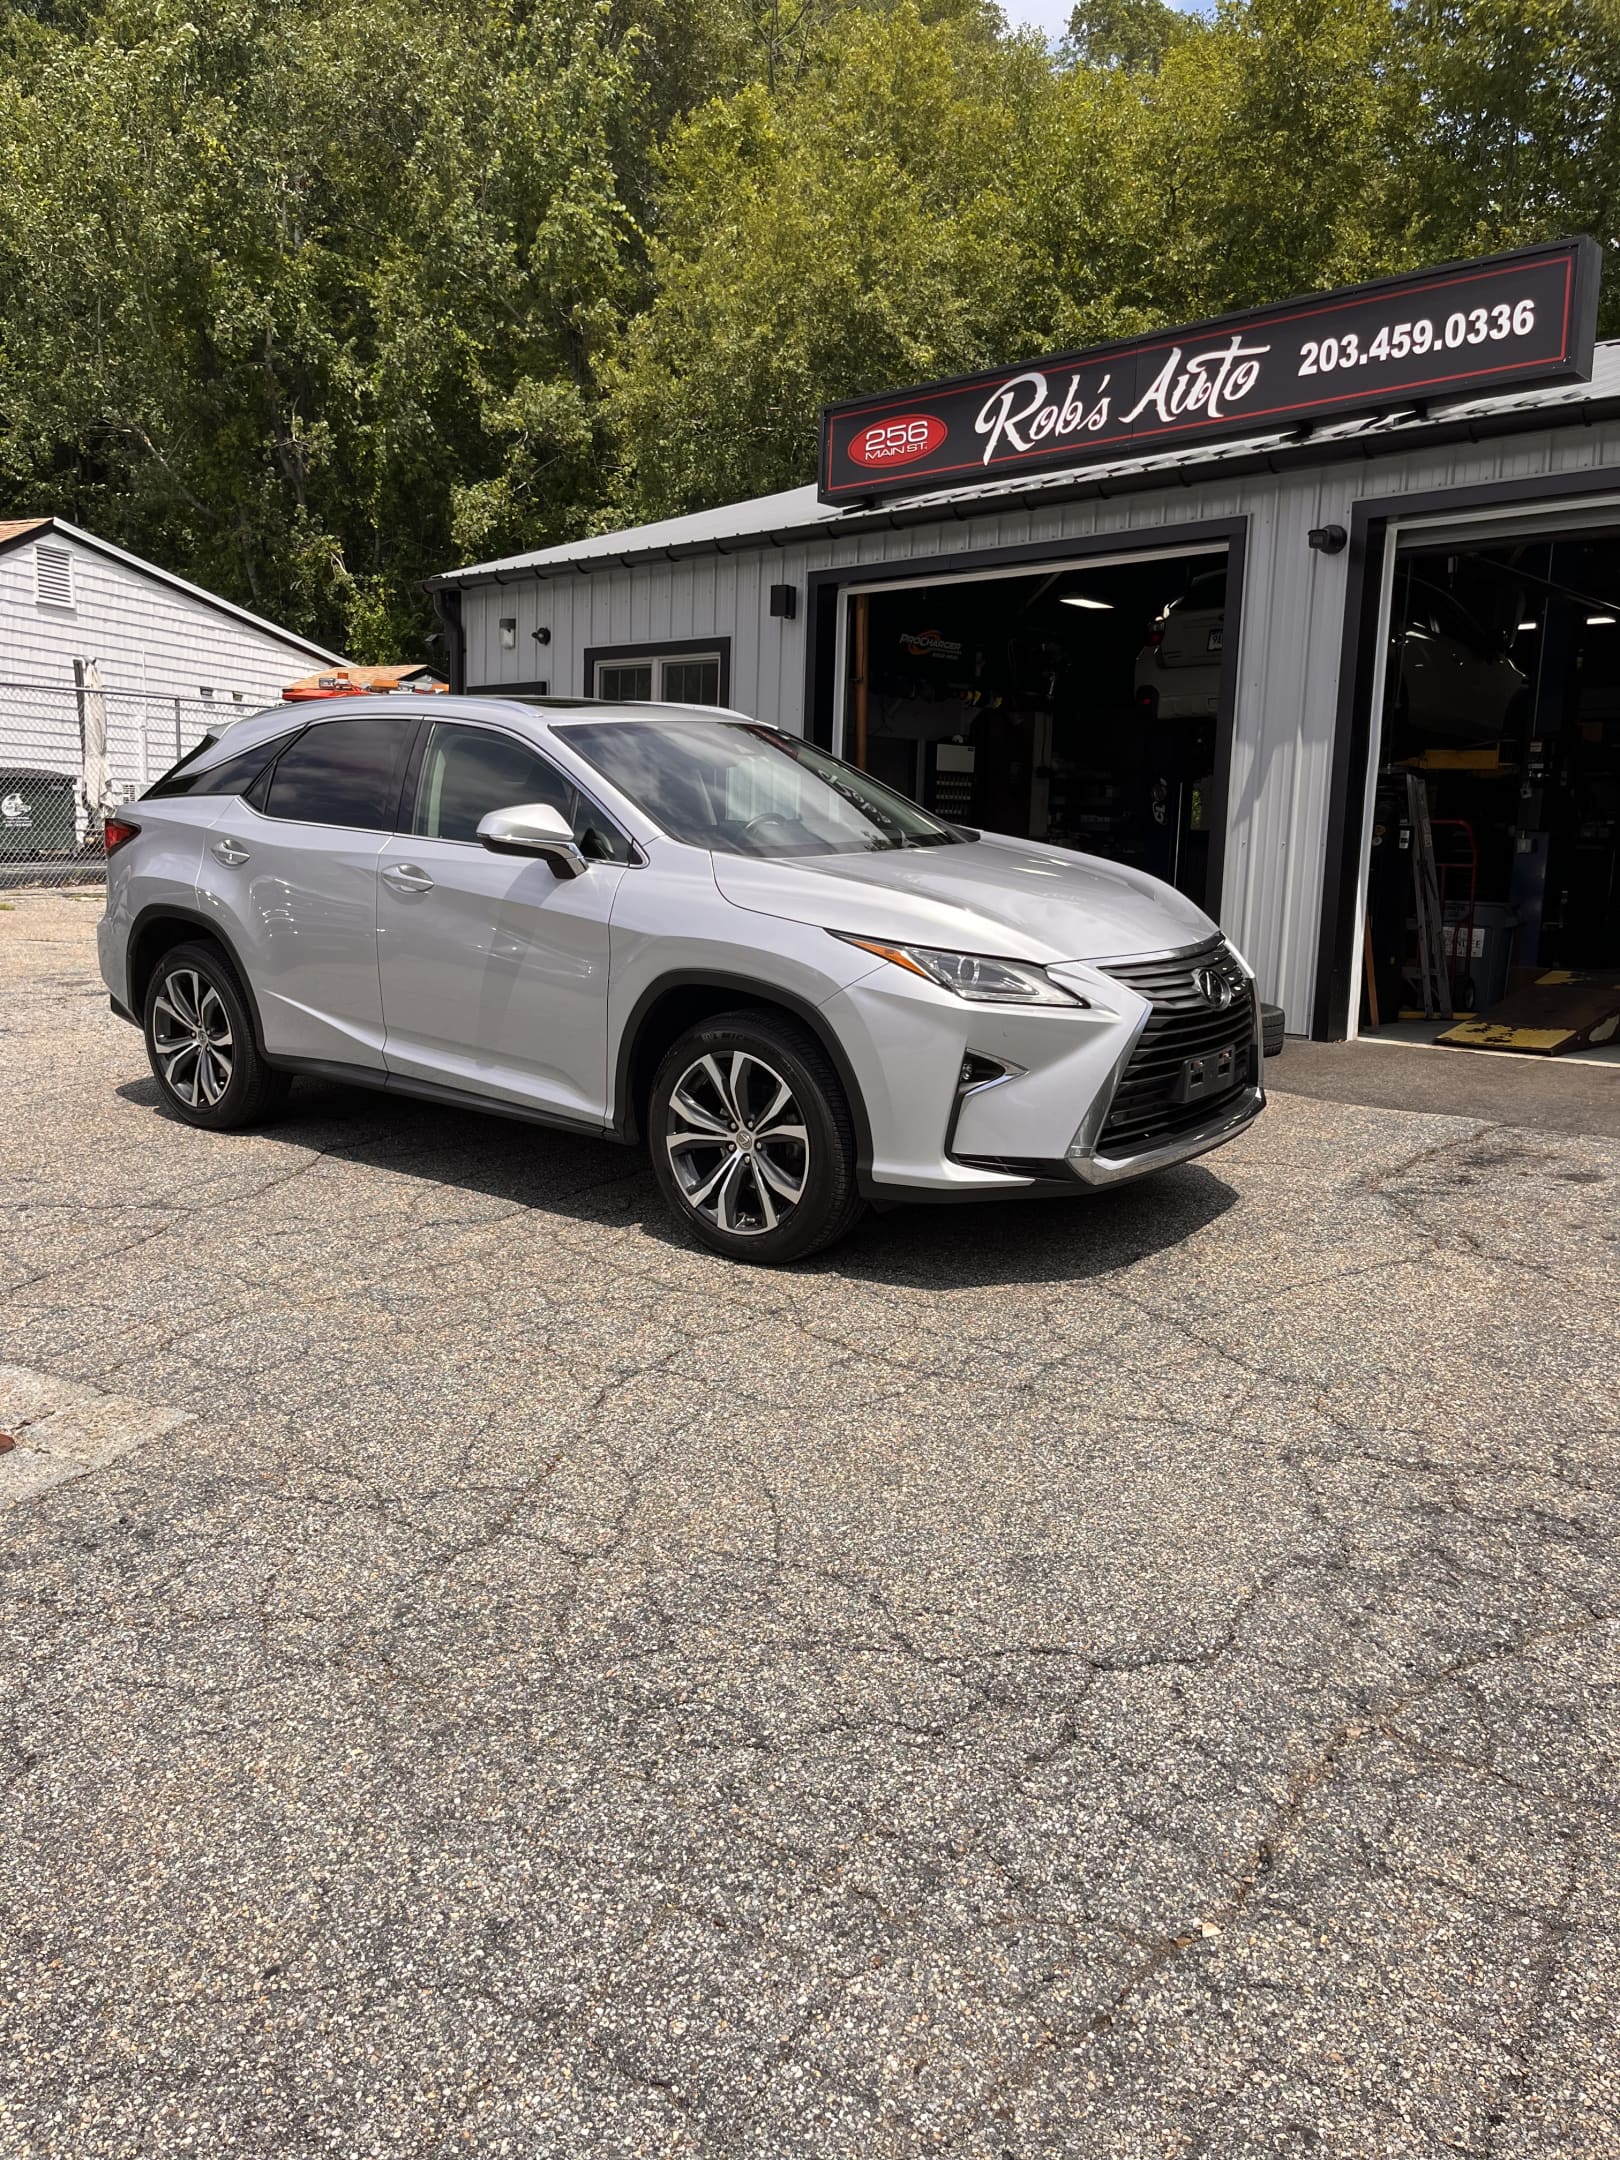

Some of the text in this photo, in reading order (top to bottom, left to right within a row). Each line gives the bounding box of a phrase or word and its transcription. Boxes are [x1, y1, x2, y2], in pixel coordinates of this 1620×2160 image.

[1297, 299, 1535, 377] 203.459.0336
[974, 336, 1271, 466] Rob's Auto
[865, 421, 928, 451] 256
[865, 442, 928, 460] MAIN ST.
